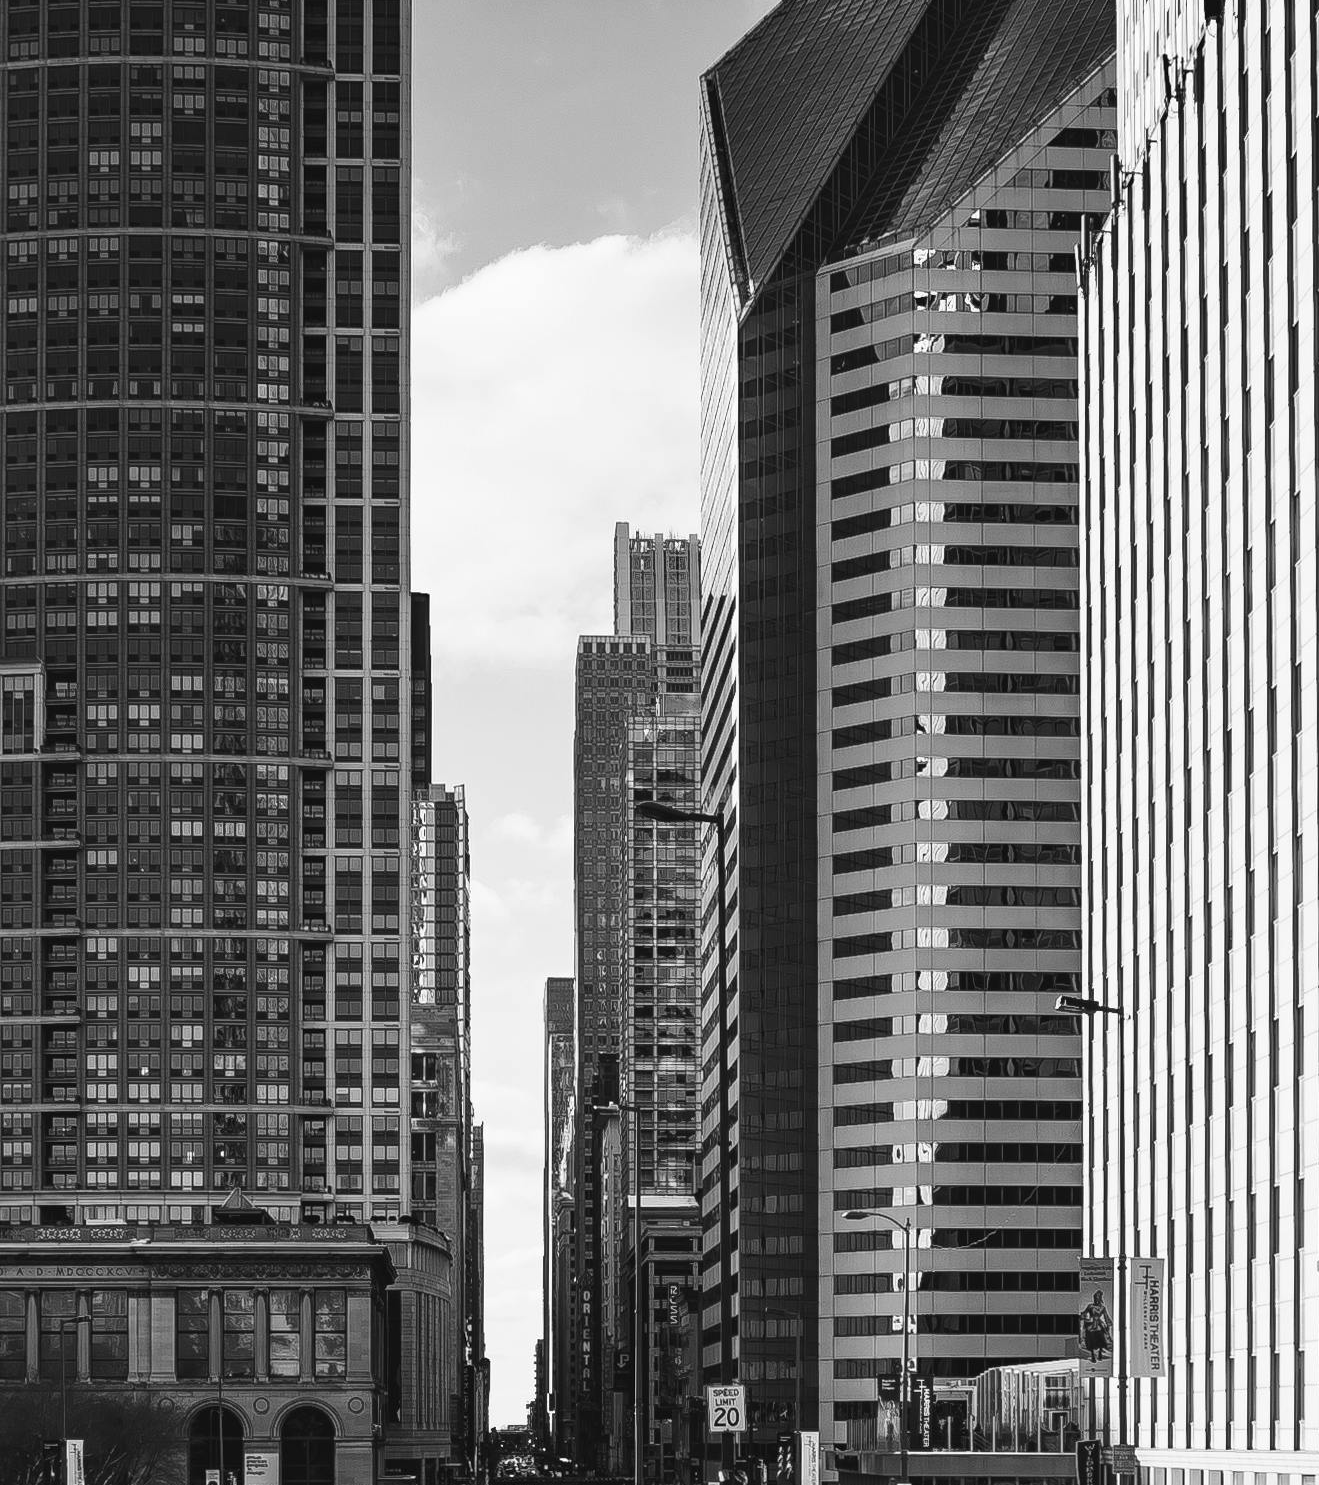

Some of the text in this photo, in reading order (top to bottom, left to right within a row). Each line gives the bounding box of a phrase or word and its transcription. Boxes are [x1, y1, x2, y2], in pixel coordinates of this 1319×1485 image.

[1149, 1279, 1161, 1370] HARRIS THEATER
[582, 1290, 591, 1392] ORIENTAL
[712, 1388, 740, 1397] SPEED
[715, 1398, 737, 1407] LIMIT
[713, 1407, 740, 1427] 20
